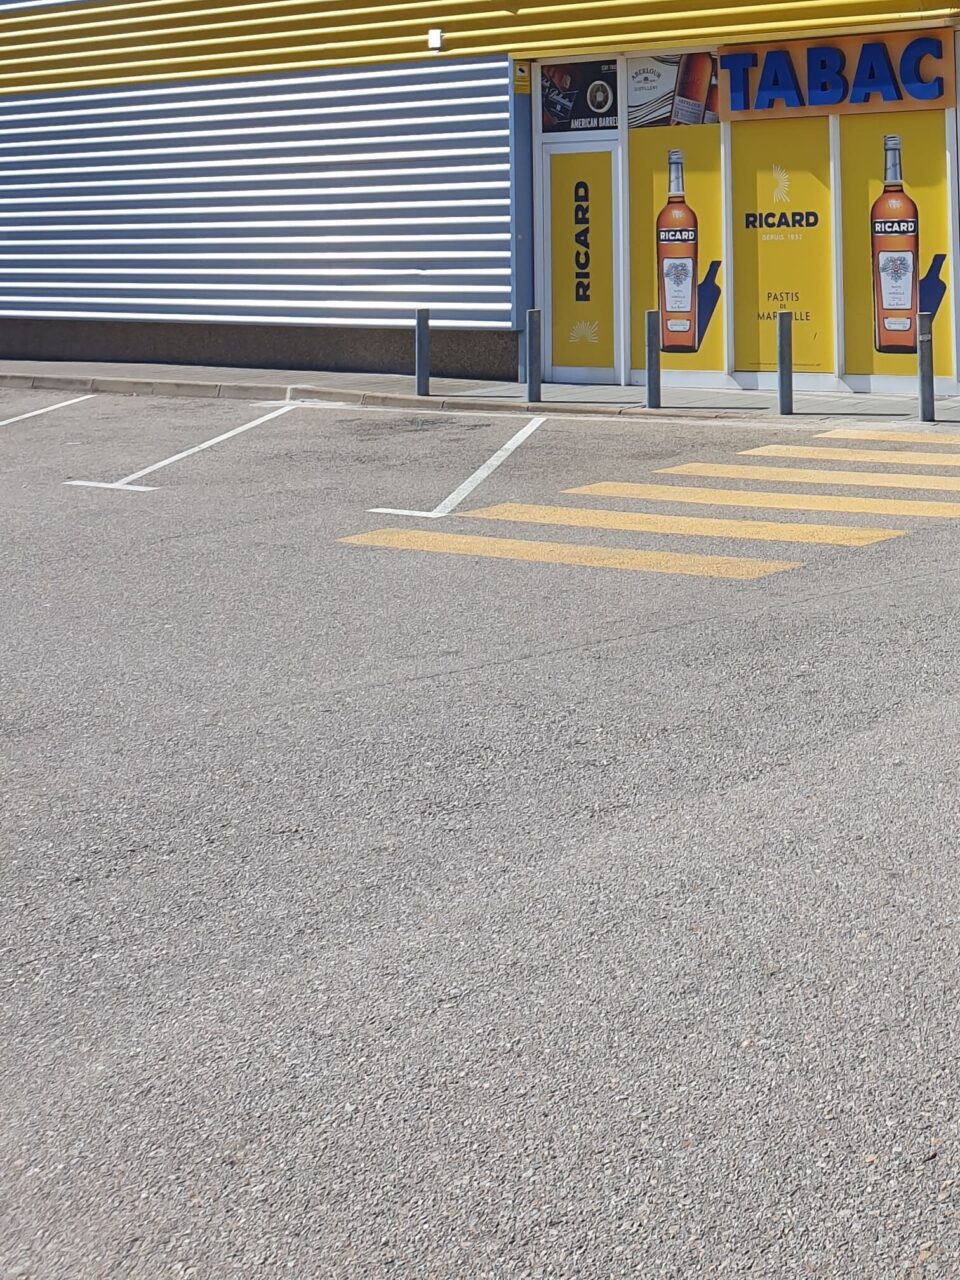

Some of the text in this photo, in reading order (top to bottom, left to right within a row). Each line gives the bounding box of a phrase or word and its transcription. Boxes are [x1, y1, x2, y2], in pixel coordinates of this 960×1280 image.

[719, 37, 944, 112] TABAC
[570, 118, 598, 129] AMERICAN
[745, 211, 819, 229] RICARD
[875, 222, 915, 232] RICARD
[575, 180, 591, 302] RICARD
[660, 231, 695, 240] RICARD
[767, 291, 800, 302] PASTIS
[757, 311, 811, 321] MARLLE
